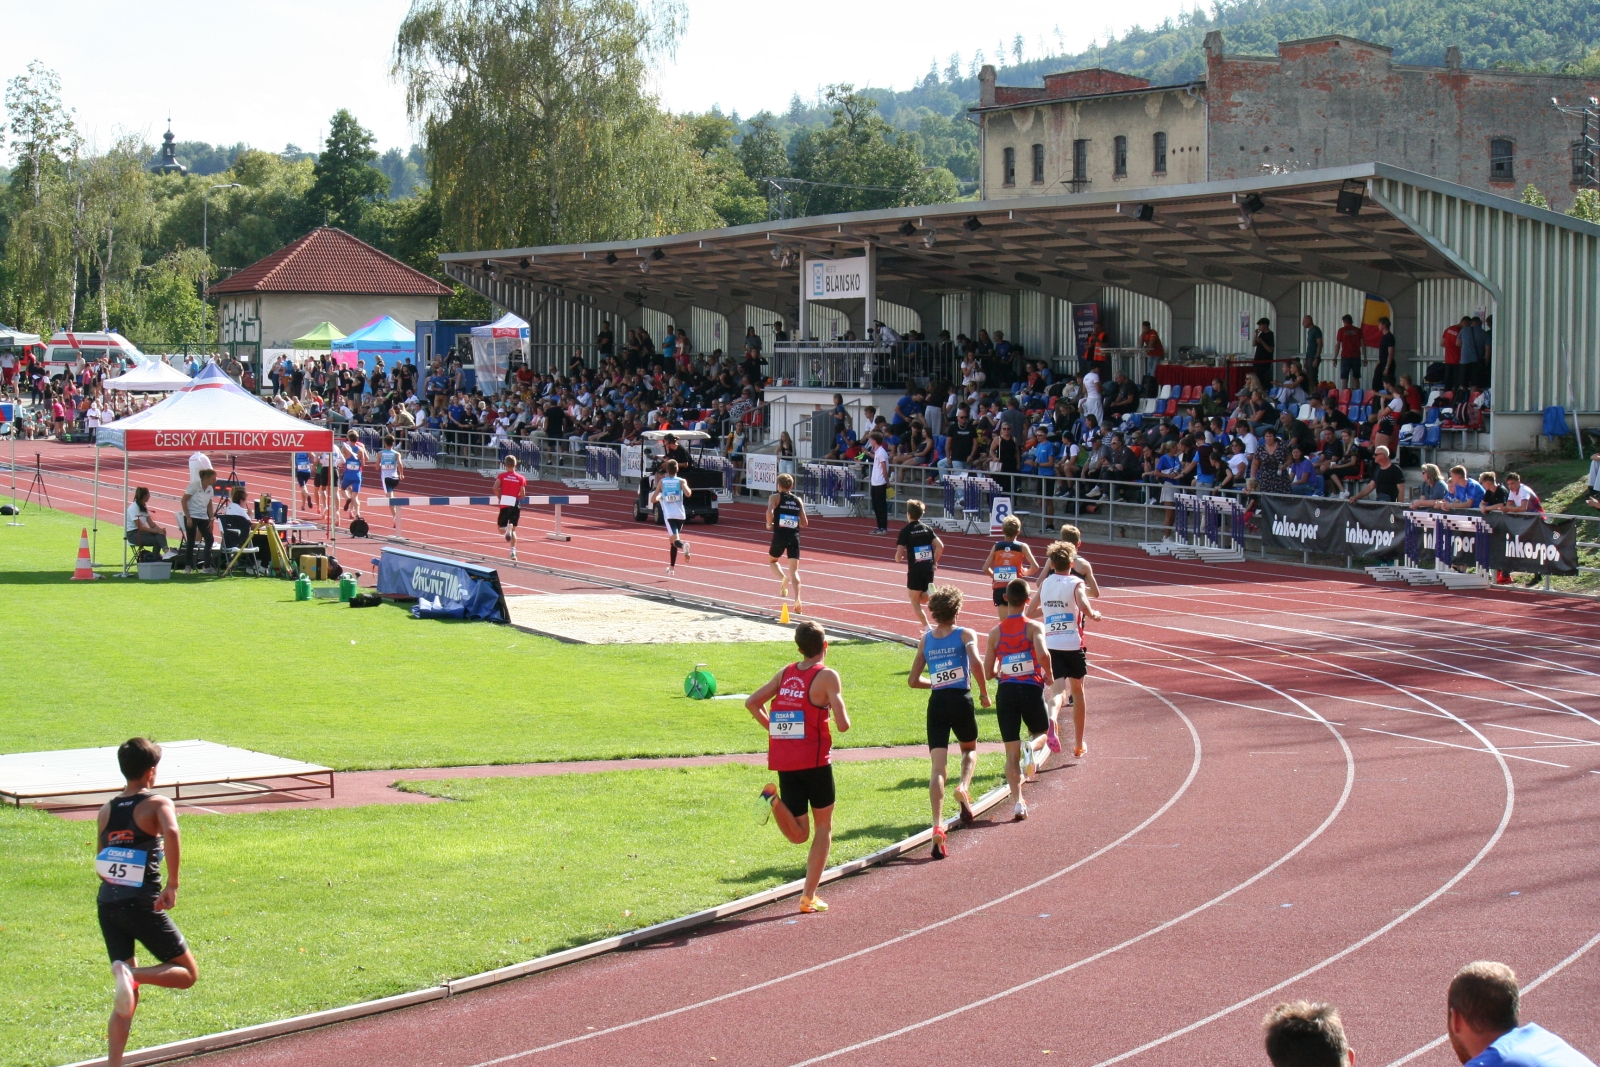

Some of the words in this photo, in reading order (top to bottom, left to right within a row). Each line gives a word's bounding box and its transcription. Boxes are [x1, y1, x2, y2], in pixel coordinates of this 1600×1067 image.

[826, 273, 861, 292] BLANSKO
[154, 430, 197, 447] ČESKÝ
[200, 430, 269, 447] ATLETICKÝ
[271, 433, 305, 448] SVAZ
[754, 471, 775, 484] BLANSKO
[995, 503, 1008, 524] 8
[1272, 514, 1319, 543] inkospor
[1345, 520, 1395, 550] inkospor
[919, 551, 930, 559] 537
[1050, 622, 1067, 631] 525
[927, 647, 956, 656] TRIATLET
[1011, 663, 1024, 673] 61
[936, 669, 957, 683] 586
[777, 722, 793, 731] 497
[107, 849, 127, 858] ČESKÁ
[108, 863, 128, 878] 45
